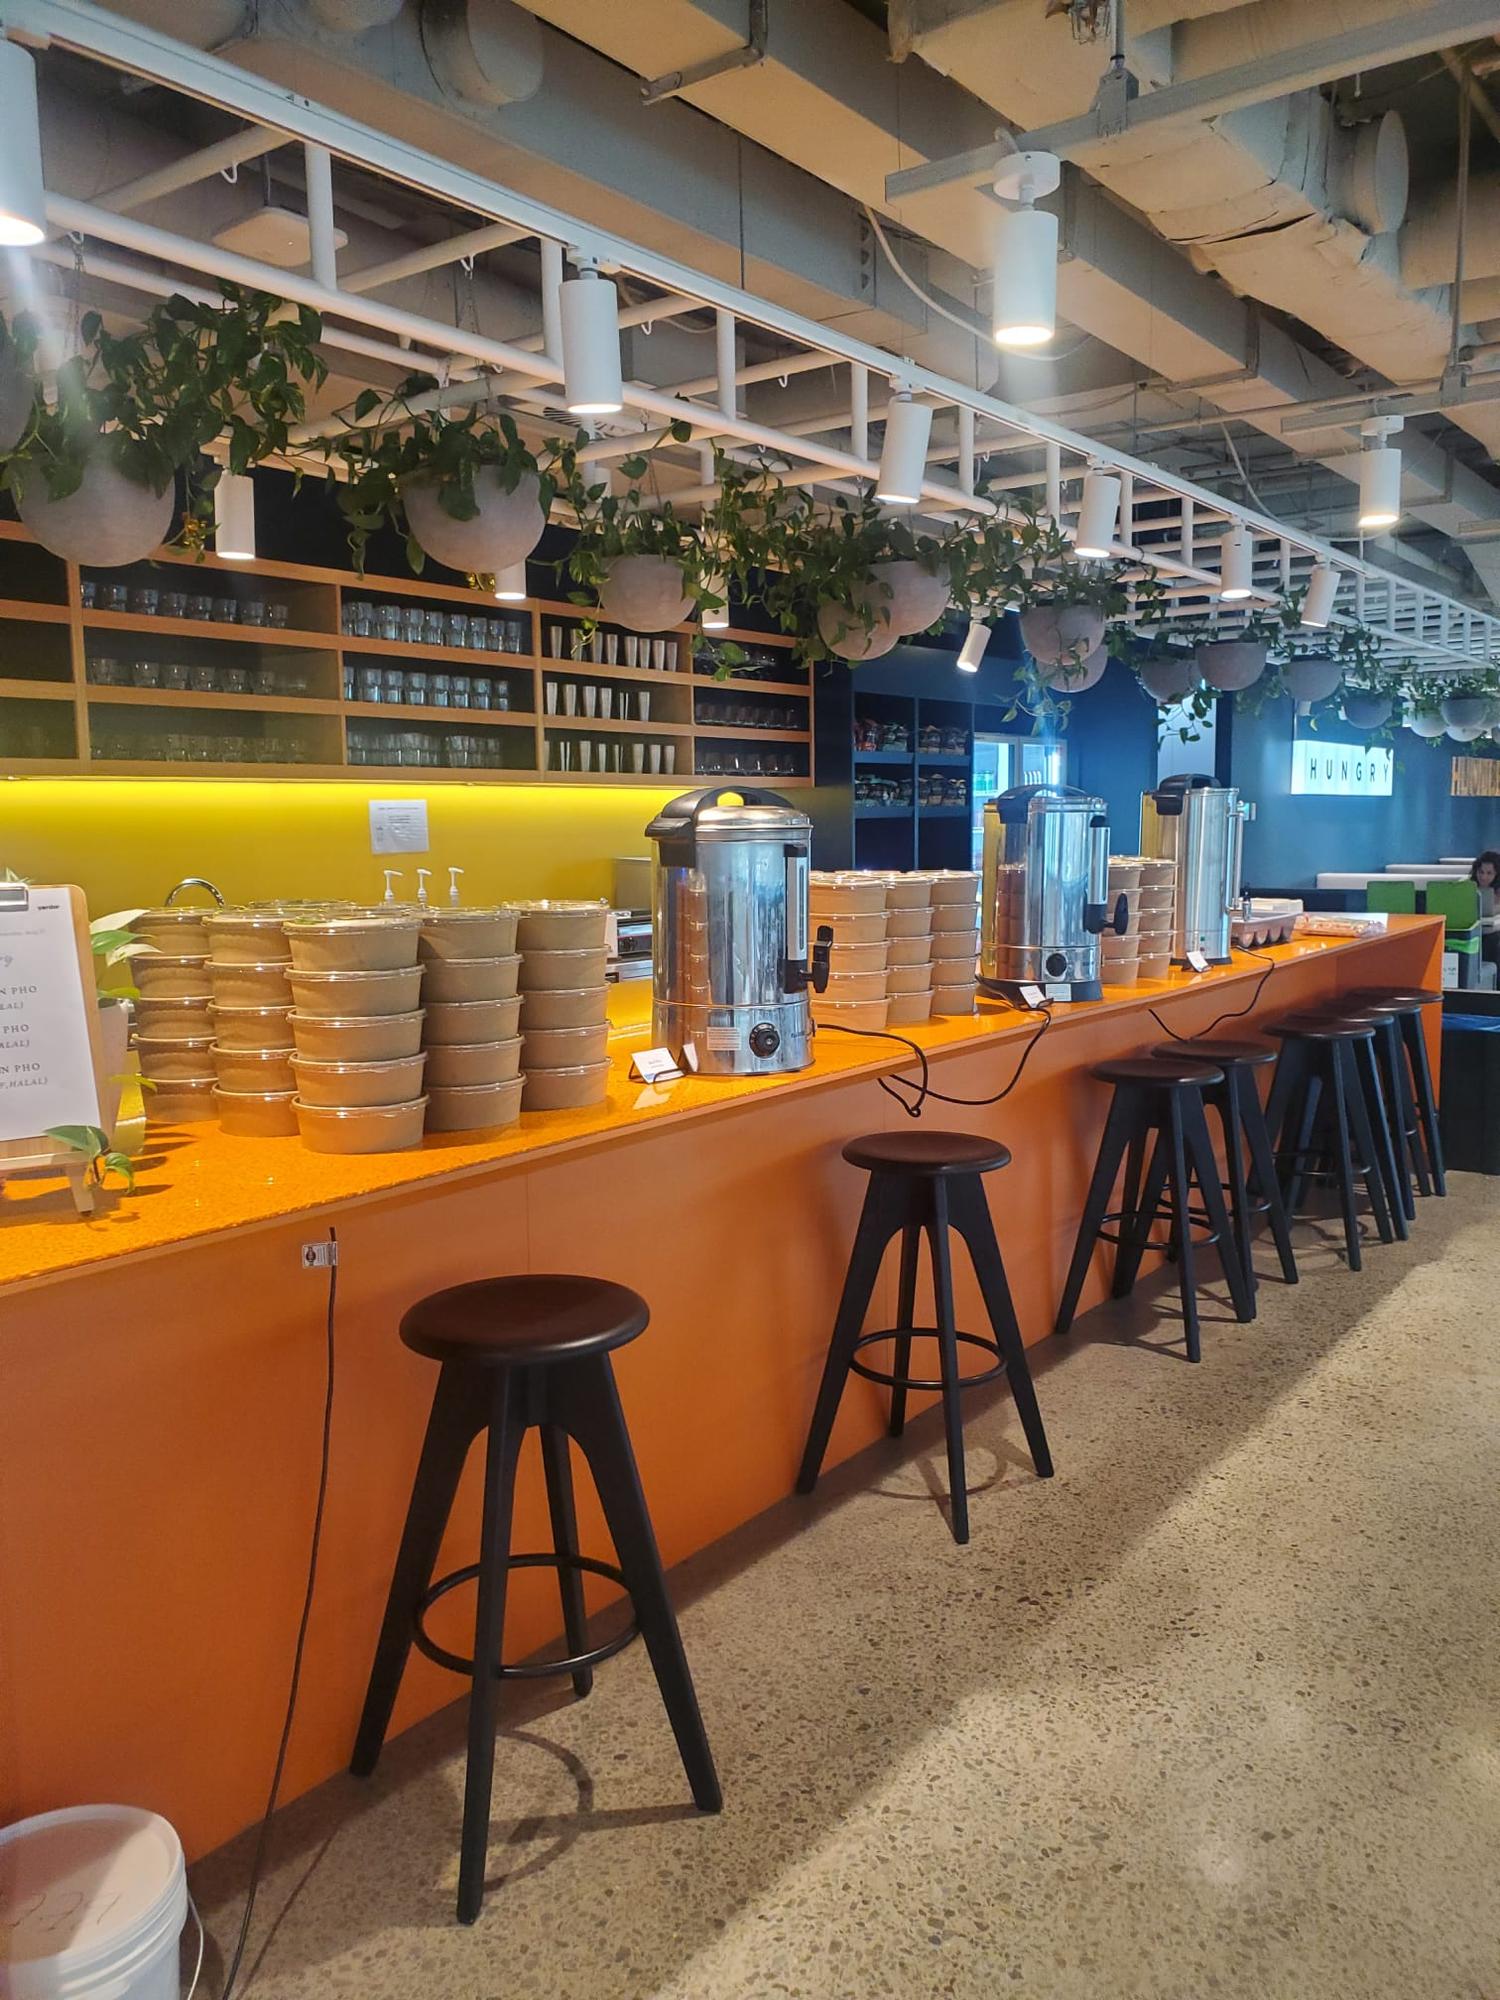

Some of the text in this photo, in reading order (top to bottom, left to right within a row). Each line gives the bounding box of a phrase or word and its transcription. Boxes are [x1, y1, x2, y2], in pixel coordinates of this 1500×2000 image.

[1309, 757, 1389, 782] HUNGRY
[11, 985, 37, 995] PHO
[3, 1024, 29, 1034] PHO
[14, 1063, 40, 1072] PHO
